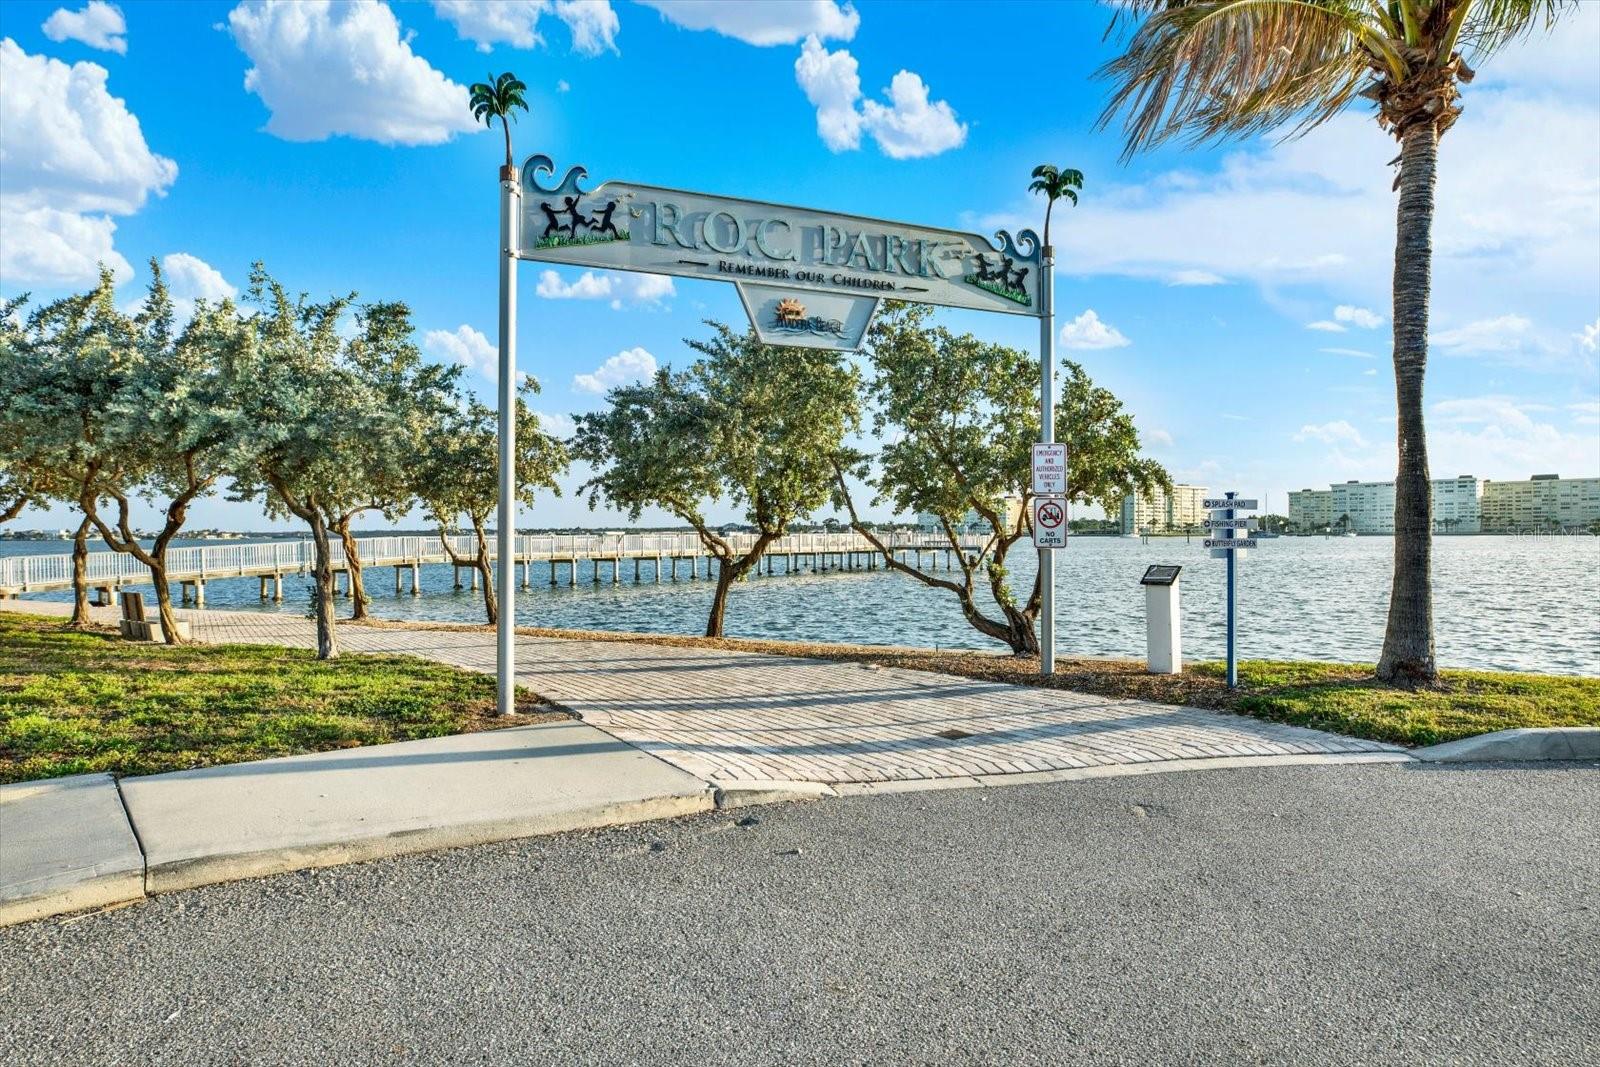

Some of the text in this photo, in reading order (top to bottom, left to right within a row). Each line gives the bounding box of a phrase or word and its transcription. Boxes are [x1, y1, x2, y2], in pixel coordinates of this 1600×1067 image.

[819, 226, 946, 279] PARK
[719, 261, 896, 291] REMEMBER OUR CHILDREN
